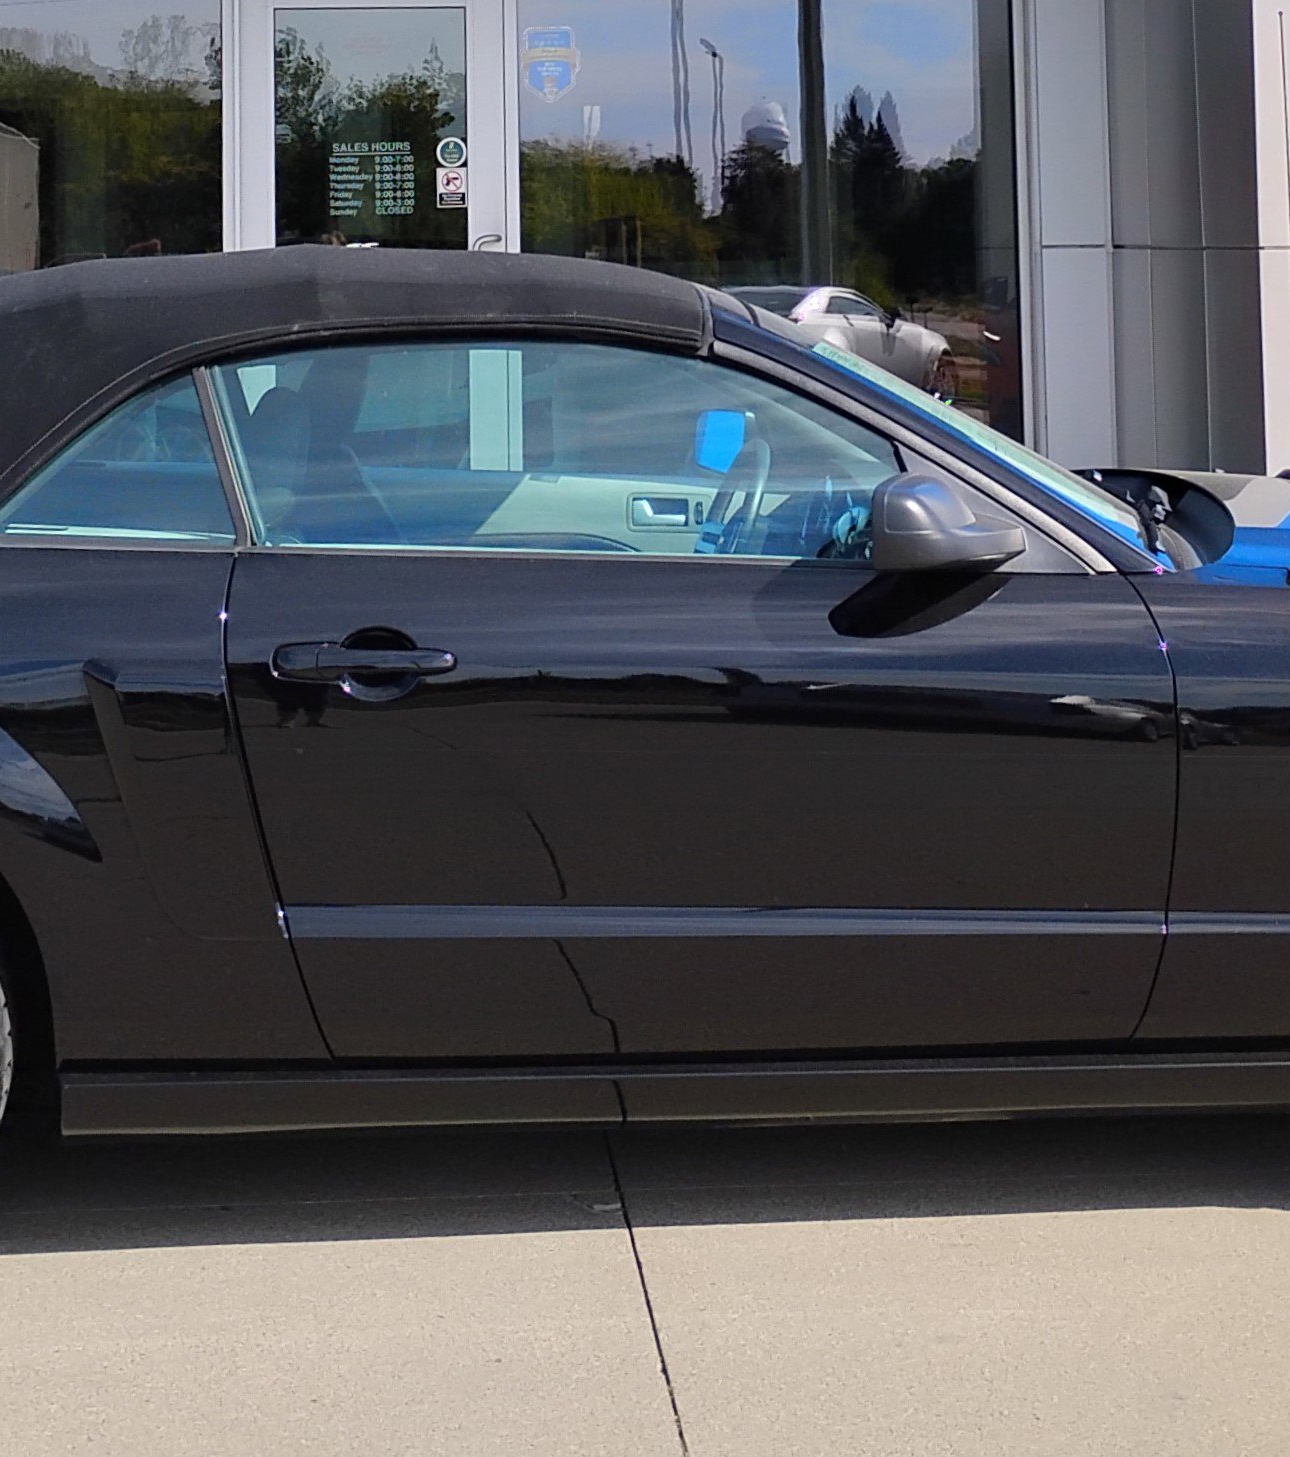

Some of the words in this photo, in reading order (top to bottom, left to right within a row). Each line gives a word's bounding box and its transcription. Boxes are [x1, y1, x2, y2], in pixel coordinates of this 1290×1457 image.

[332, 142, 369, 152] SALES
[371, 142, 411, 152] HOURS
[328, 156, 360, 165] Monday
[329, 164, 360, 174] Tuesday
[329, 173, 373, 182] Wednesday
[329, 182, 364, 191] Thursday
[329, 190, 353, 199] Friday
[329, 199, 363, 208] Saturday
[329, 208, 358, 217] Sunday
[375, 206, 414, 215] CLOSED
